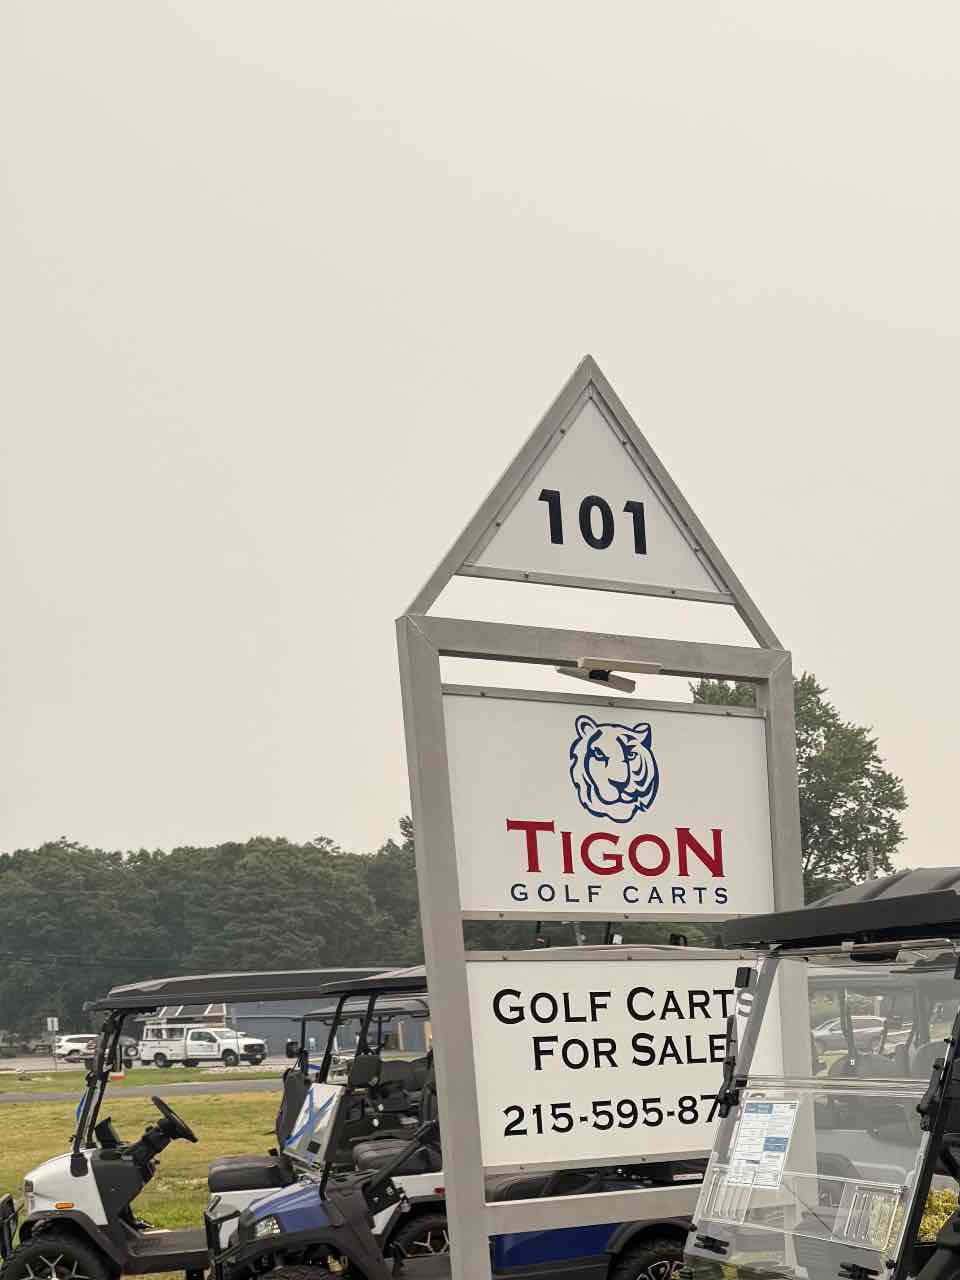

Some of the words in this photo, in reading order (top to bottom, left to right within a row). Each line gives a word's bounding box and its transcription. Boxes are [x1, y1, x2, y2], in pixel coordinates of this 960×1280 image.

[538, 489, 648, 555] 101
[506, 820, 725, 878] TIGON
[511, 884, 601, 904] GOLF
[623, 885, 728, 905] CARTS
[493, 988, 611, 1024] GOLF
[532, 1036, 618, 1070] FOR
[632, 1032, 727, 1067] SALE
[503, 1094, 719, 1136] 215-595-87
